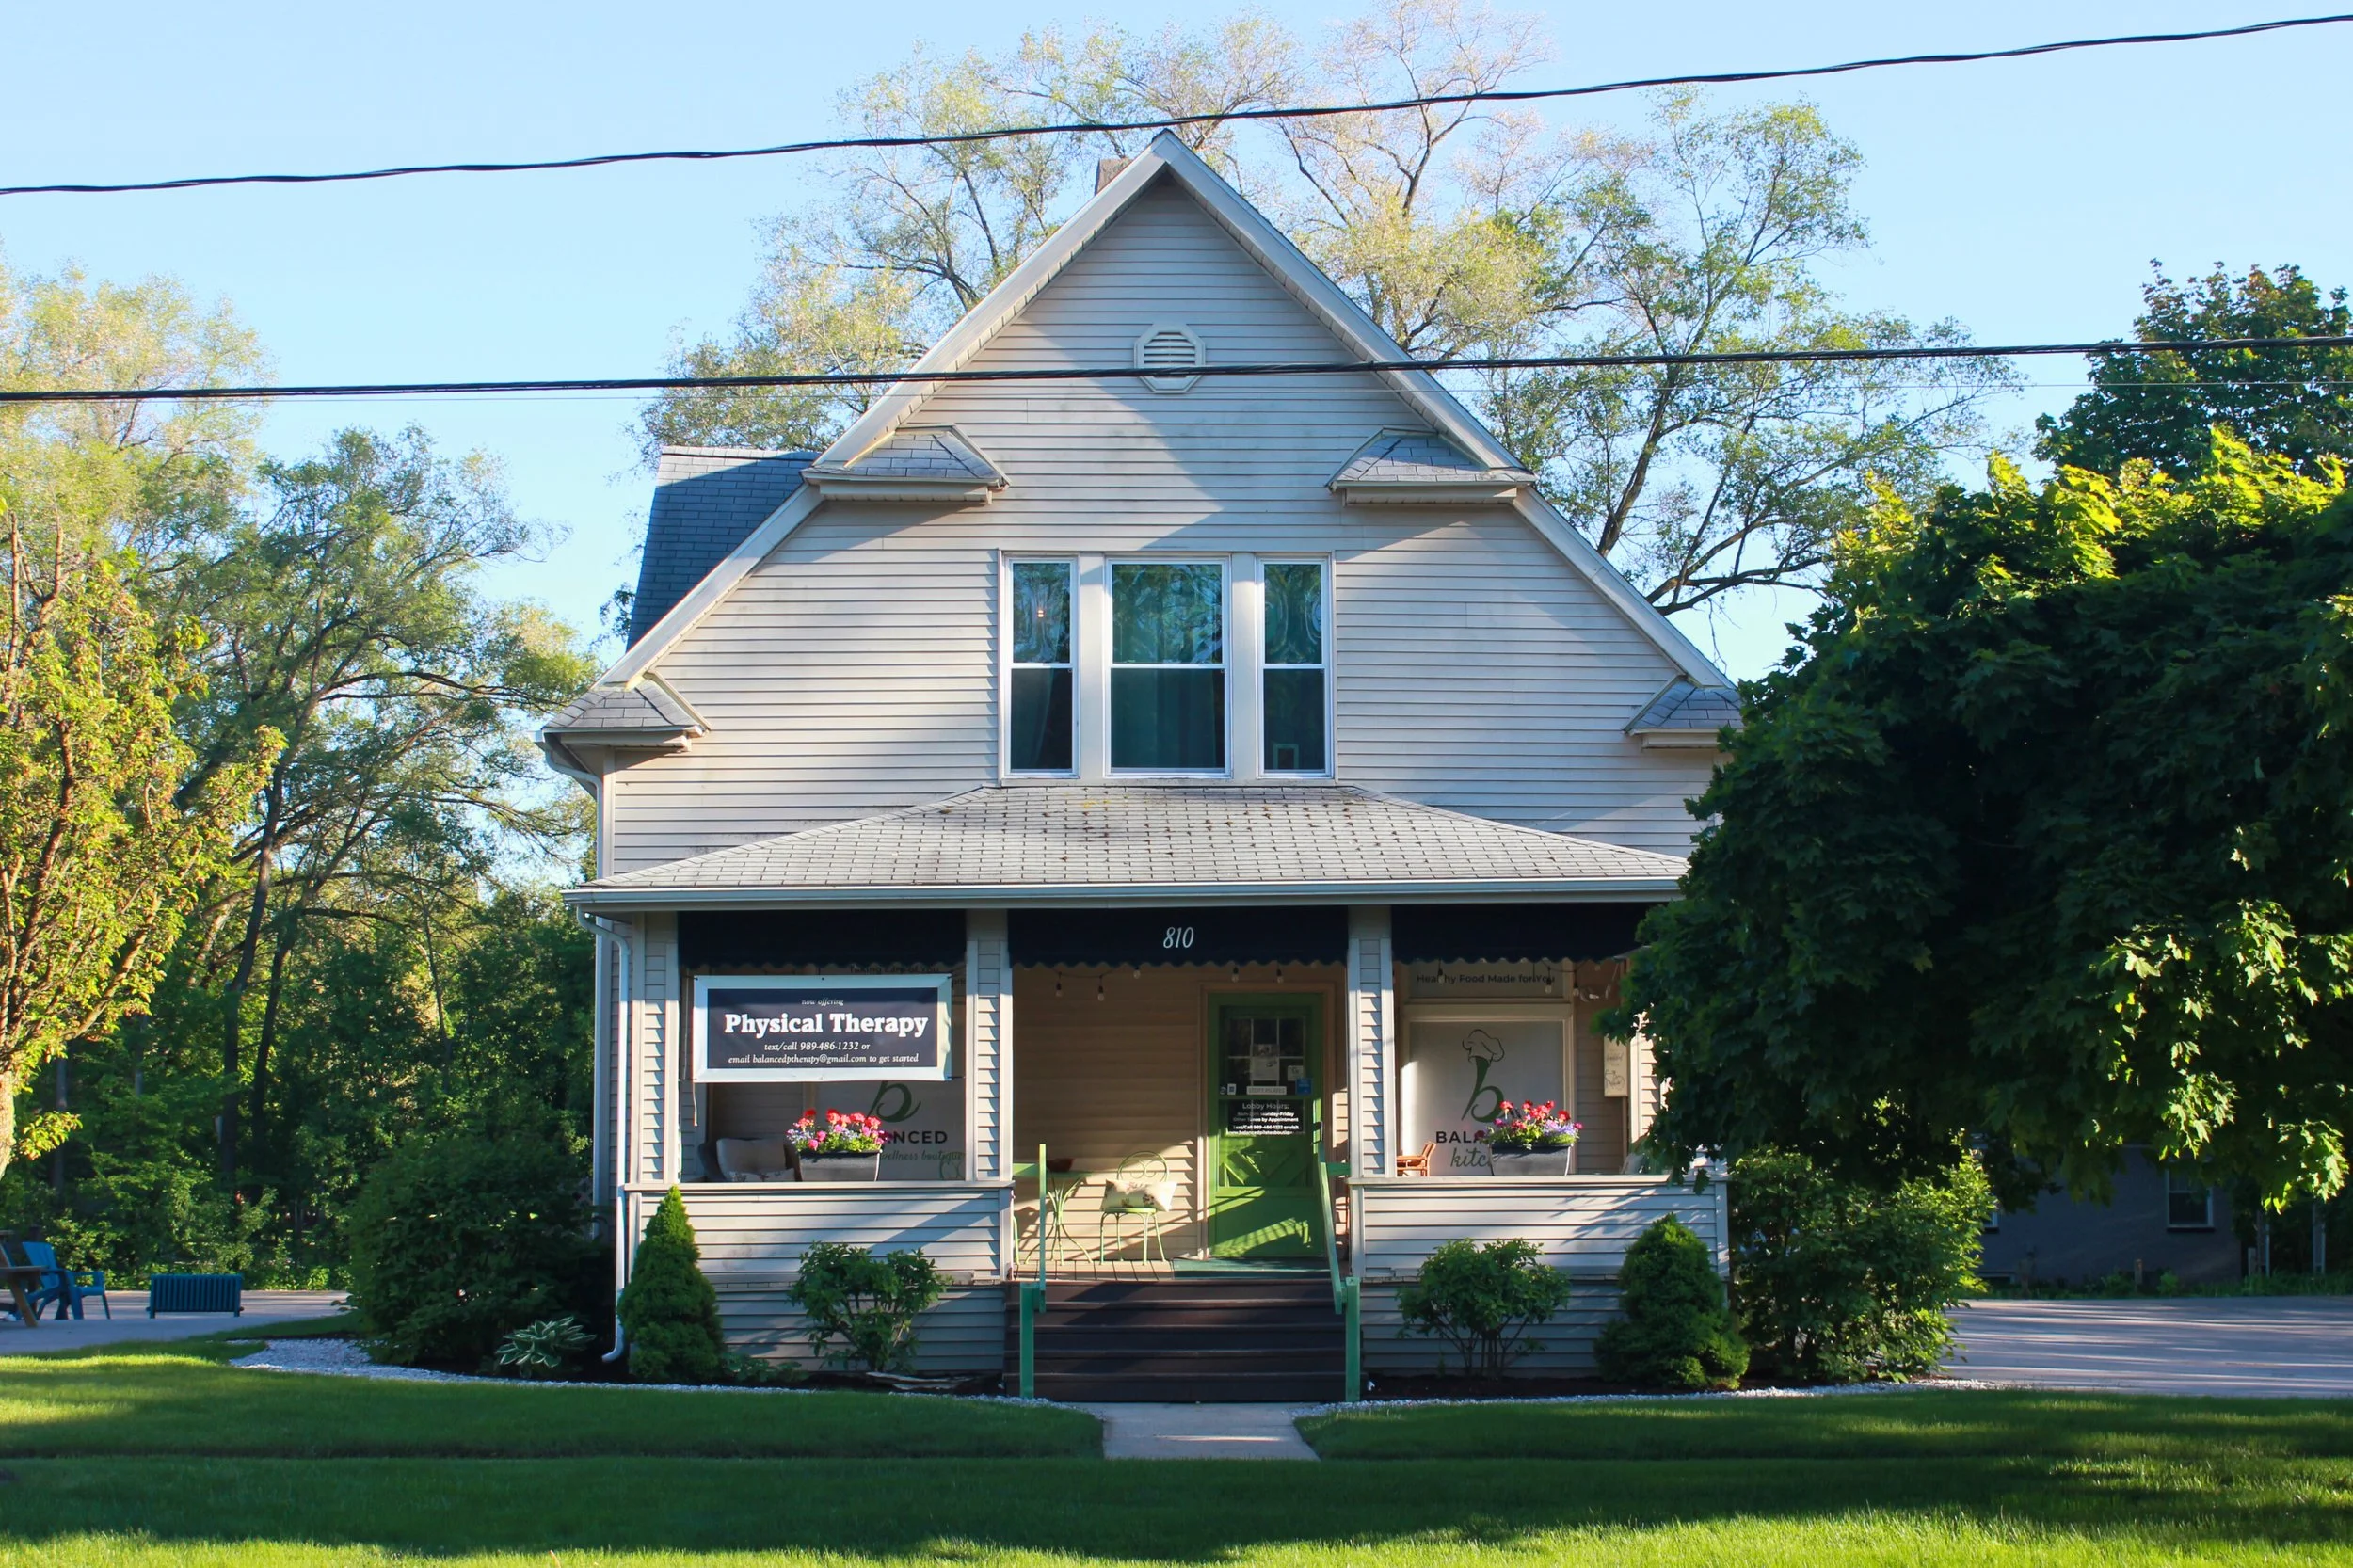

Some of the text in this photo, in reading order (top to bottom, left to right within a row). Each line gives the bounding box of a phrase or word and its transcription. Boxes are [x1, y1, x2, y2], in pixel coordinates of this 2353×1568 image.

[1163, 926, 1194, 949] 810
[1459, 974, 1484, 983] Food
[1488, 974, 1515, 983] Made
[1518, 973, 1532, 983] for
[817, 998, 844, 1007] offering
[724, 1012, 929, 1039] Physical Therapy
[764, 1041, 797, 1051] text/call
[800, 1041, 859, 1050] 989-486-1232
[728, 1053, 919, 1064] email balancedptherapy@gmail.com to get started
[1241, 1102, 1265, 1111] Lobby
